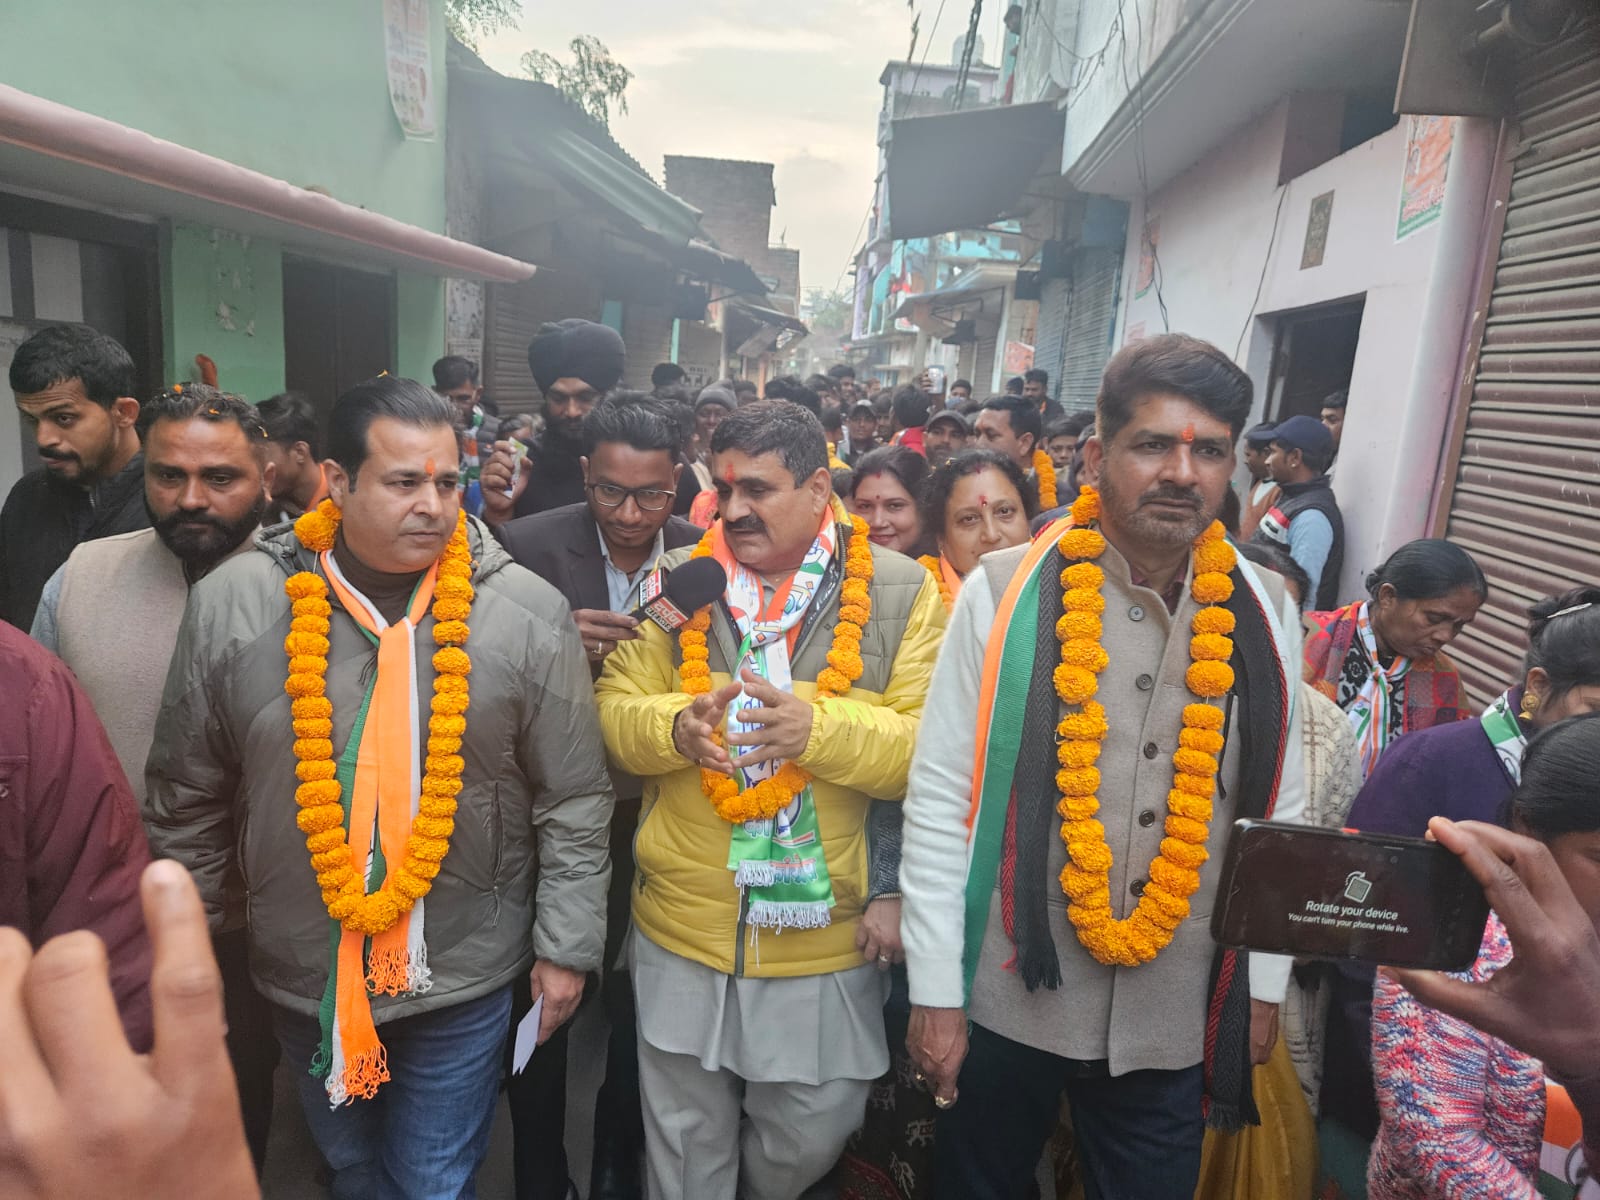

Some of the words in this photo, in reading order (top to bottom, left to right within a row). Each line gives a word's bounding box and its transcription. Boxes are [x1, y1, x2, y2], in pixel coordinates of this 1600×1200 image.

[1305, 900, 1340, 914] Rotate
[1340, 906, 1364, 917] your
[1365, 907, 1399, 920] device
[1288, 913, 1301, 922] You
[1302, 915, 1321, 924] can't
[1321, 917, 1336, 925] turn
[1336, 919, 1353, 927] your
[1353, 920, 1376, 930] phone
[1376, 923, 1395, 932] while
[1395, 925, 1409, 933] live.
